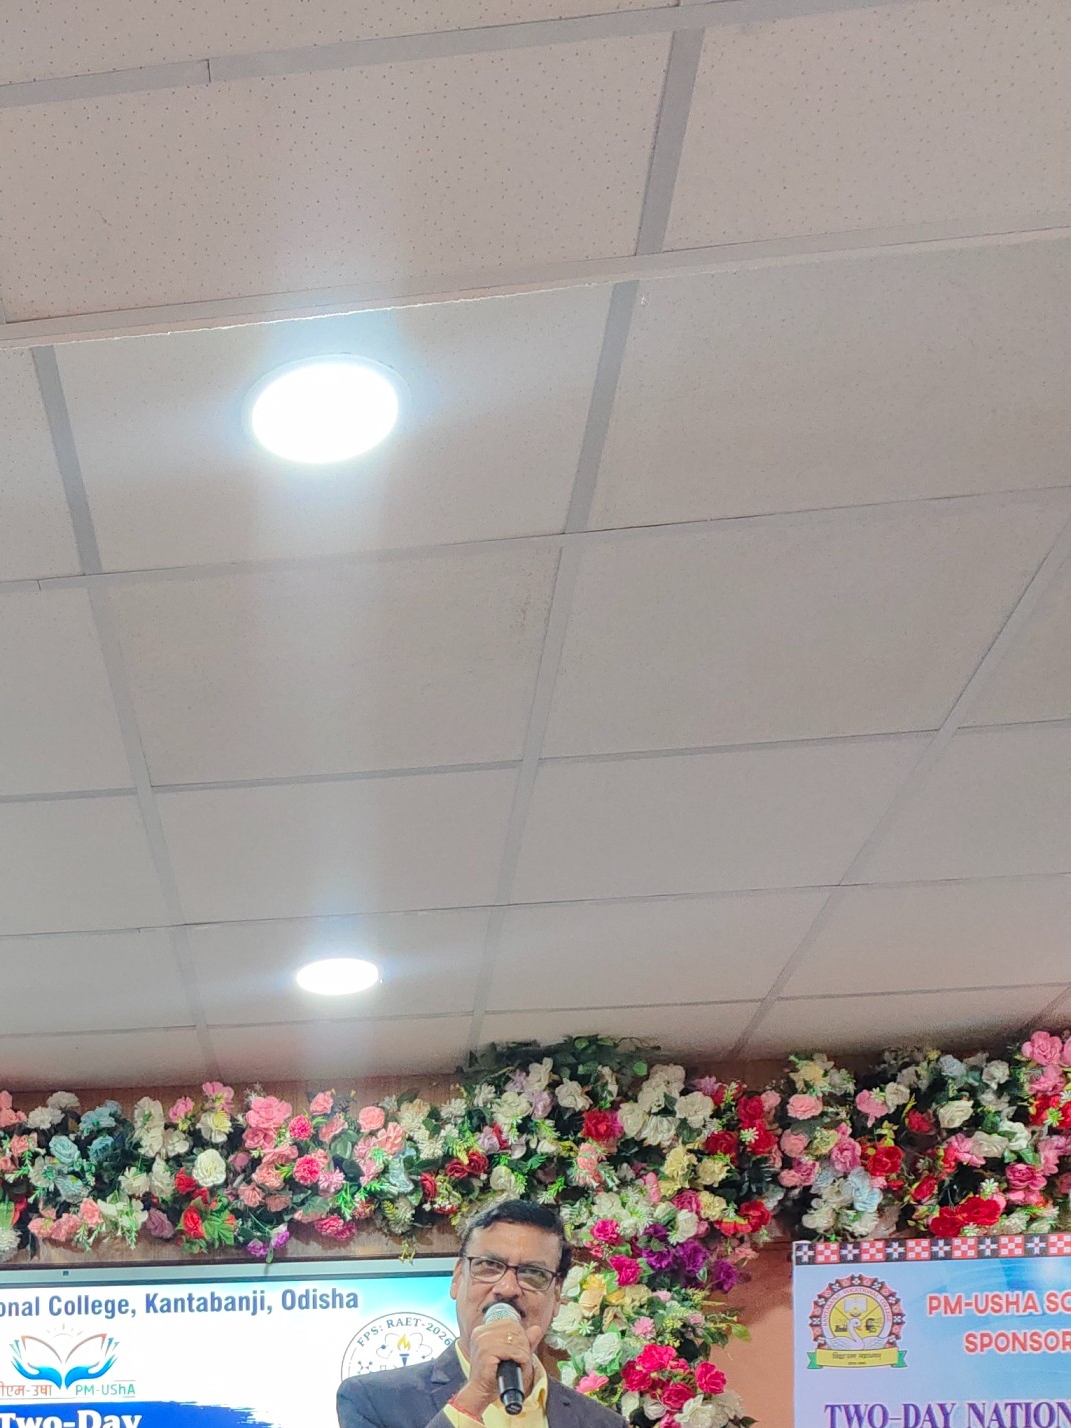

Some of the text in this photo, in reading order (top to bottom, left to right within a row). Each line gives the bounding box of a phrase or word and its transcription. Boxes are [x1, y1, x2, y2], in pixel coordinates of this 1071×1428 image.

[48, 1294, 137, 1320] College,
[145, 1290, 273, 1317] Kantabanji,
[281, 1288, 359, 1311] Odisha
[928, 1292, 1040, 1316] PM-USHA
[357, 1325, 384, 1347] FPS:
[75, 1382, 136, 1396] PM-UShA
